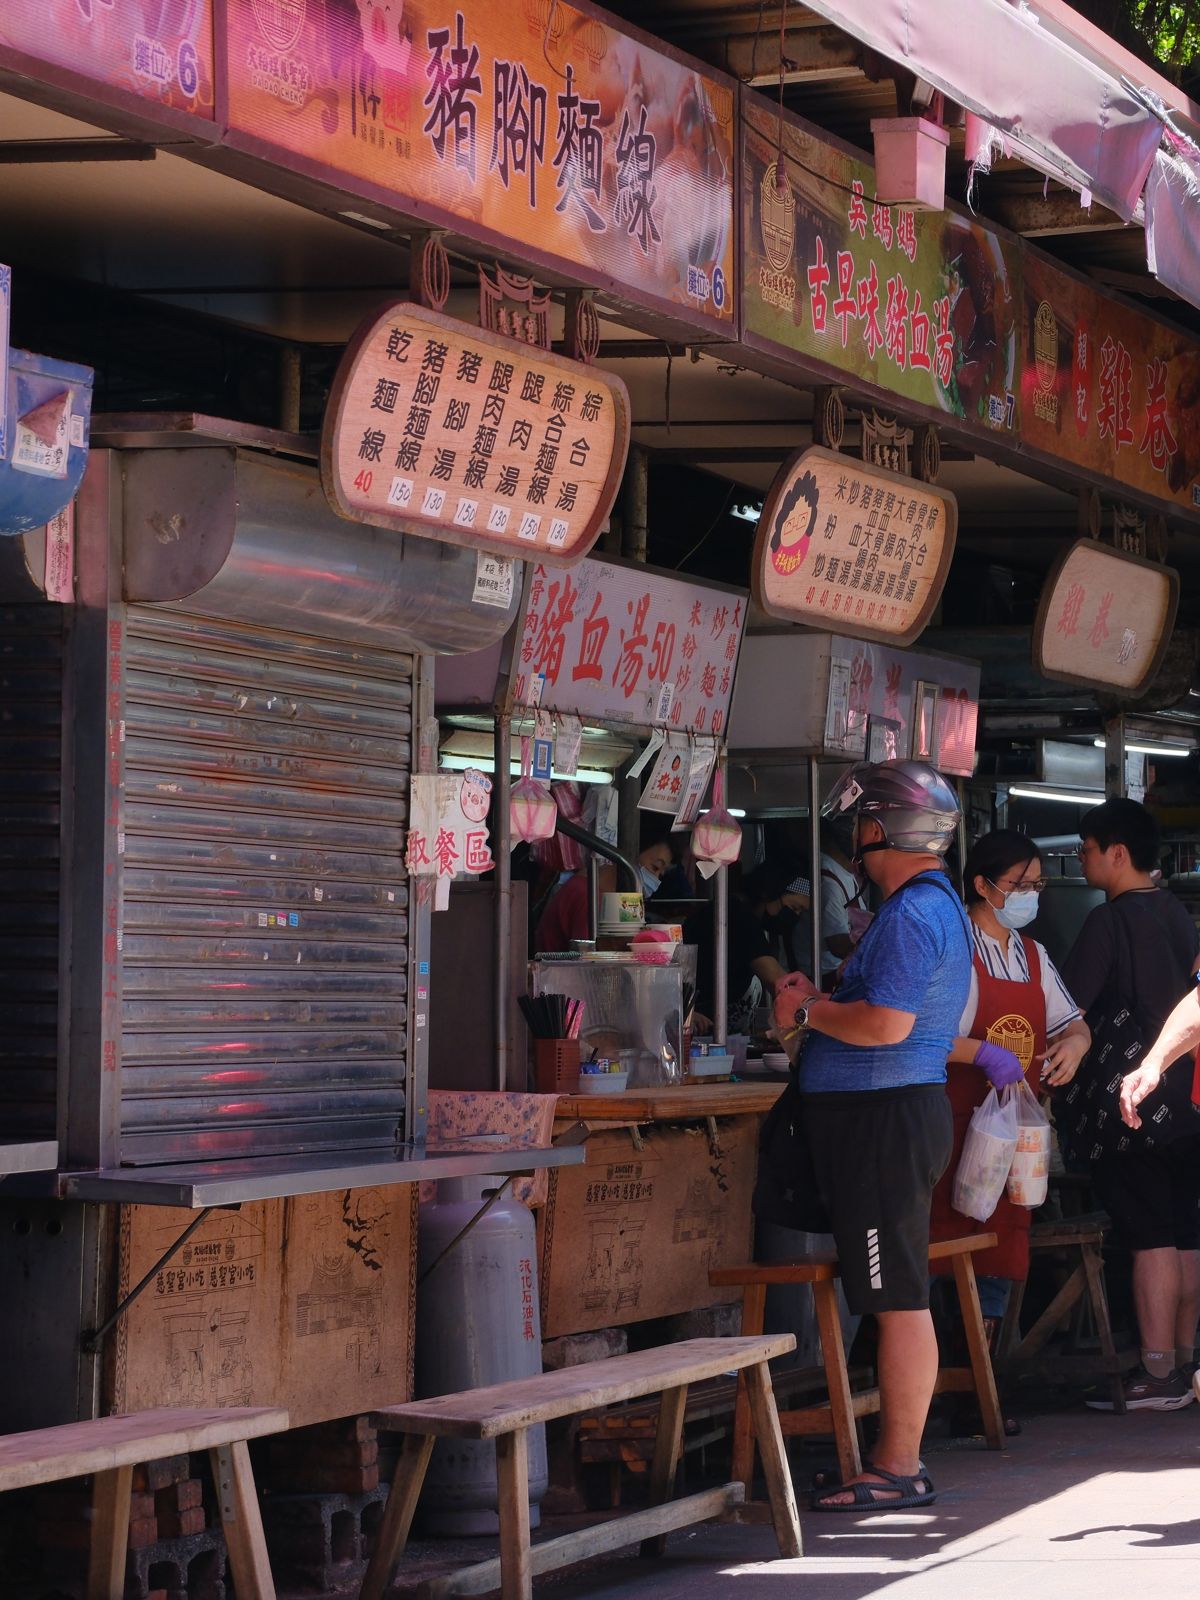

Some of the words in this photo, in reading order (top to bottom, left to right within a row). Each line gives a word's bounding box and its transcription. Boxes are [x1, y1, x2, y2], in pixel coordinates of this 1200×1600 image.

[424, 13, 662, 255] 豬腳麵線
[807, 236, 954, 388] 古早味豬血湯
[358, 327, 414, 463] 乾麵線
[395, 339, 449, 472] 豬腳麵線
[429, 350, 483, 482] 豬腳湯
[463, 360, 514, 489] 腿肉麵線
[495, 371, 545, 497] 腿肉湯
[1096, 336, 1178, 472] 雞卷
[354, 470, 373, 494] 40
[526, 380, 576, 505] 綜合麵線
[555, 390, 603, 512] 綜合湯
[391, 482, 410, 502] 150
[424, 493, 443, 511] 130
[457, 504, 476, 524] 150
[490, 508, 508, 527] 130
[522, 518, 538, 536] 150
[550, 523, 566, 541] 130
[812, 476, 849, 578] 米粉炒
[827, 480, 861, 583] 炒麵
[837, 485, 874, 586] 豬血湯
[533, 574, 677, 698] 豬血湯50
[806, 586, 816, 604] 40
[819, 590, 829, 607] 40
[675, 599, 702, 692] 米粉炒
[700, 605, 729, 698] 炒麵
[671, 702, 682, 725] 40
[695, 706, 706, 730] 40
[712, 709, 723, 732] 60
[406, 827, 496, 875] 取餐區
[156, 1269, 205, 1294] 慈聖宮小吃
[210, 1264, 255, 1288] 慈聖宮小吃
[519, 1258, 535, 1342] 液化石油氣
